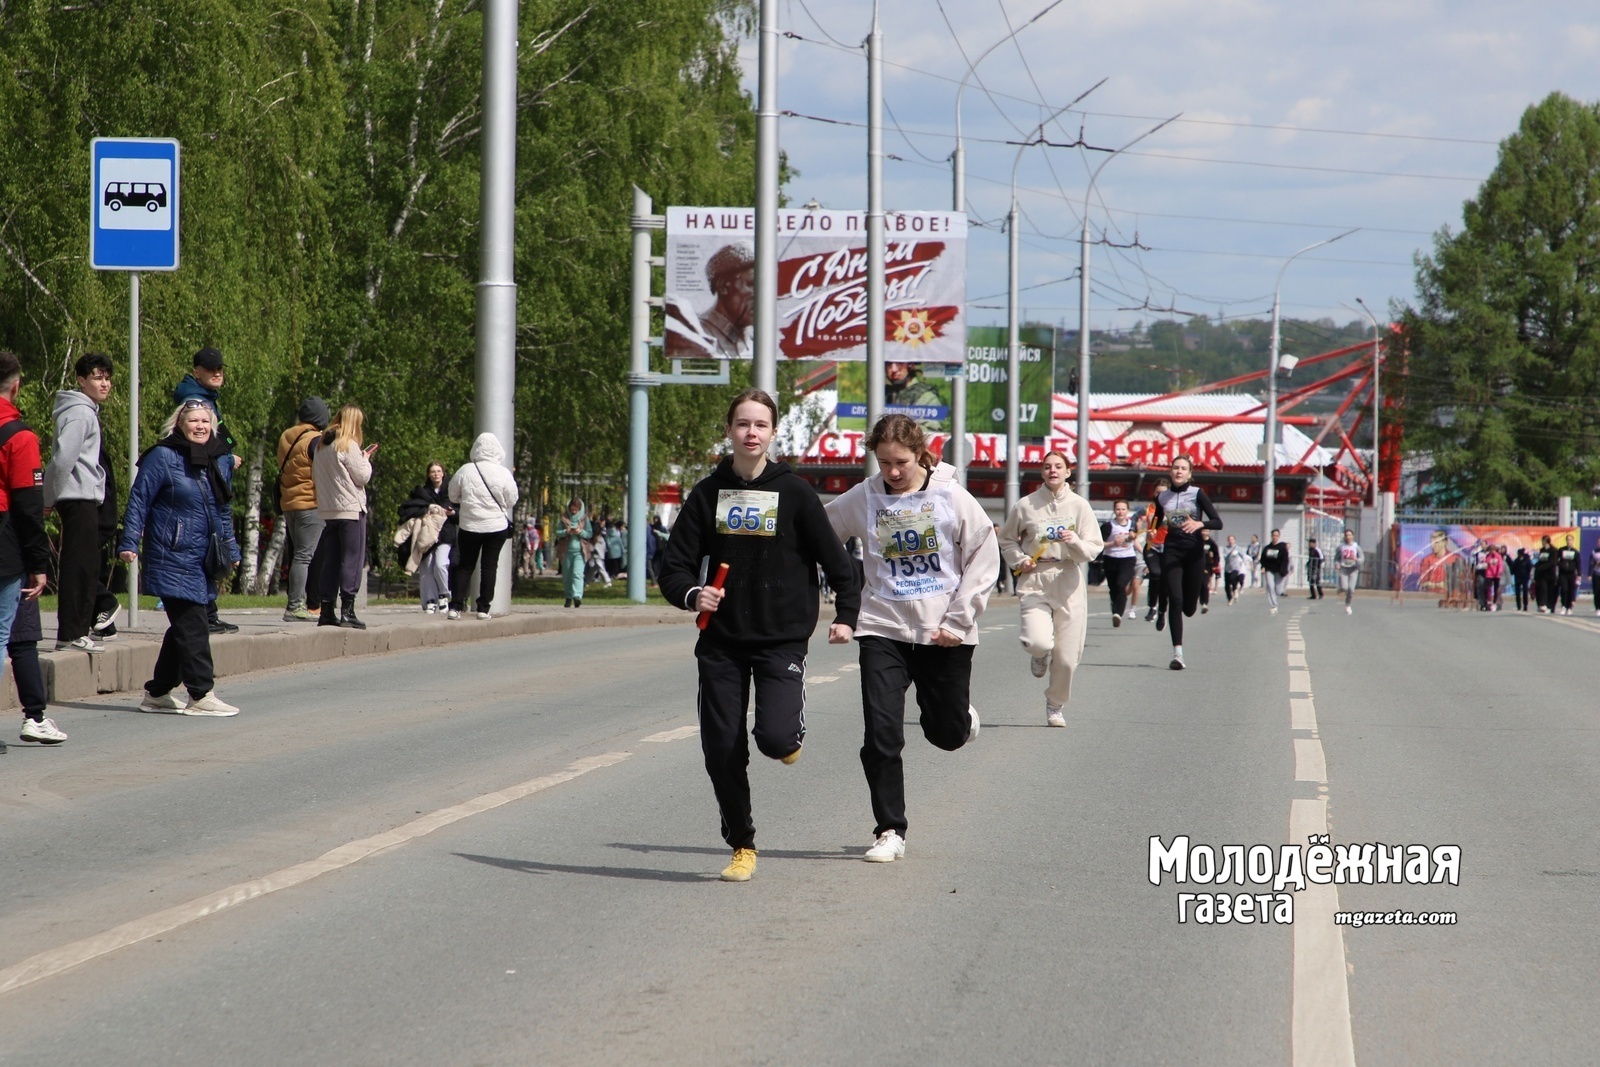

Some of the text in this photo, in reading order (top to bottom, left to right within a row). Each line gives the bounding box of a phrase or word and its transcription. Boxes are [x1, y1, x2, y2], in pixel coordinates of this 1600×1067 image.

[686, 214, 754, 230] НАШЕ
[847, 215, 950, 232] ПВОЕ!
[823, 240, 918, 287] Днм
[782, 266, 933, 346] Побеы!
[833, 479, 842, 489] 3
[992, 483, 1000, 493] 7
[1108, 486, 1121, 496] 10
[727, 505, 761, 531] 65
[766, 519, 774, 531] 8
[892, 529, 921, 553] 19
[927, 537, 936, 548] 8
[885, 552, 942, 577] 1530
[896, 576, 938, 588] РЕСПУБЛИКА
[892, 584, 944, 596] БАШКОРТОСТАН
